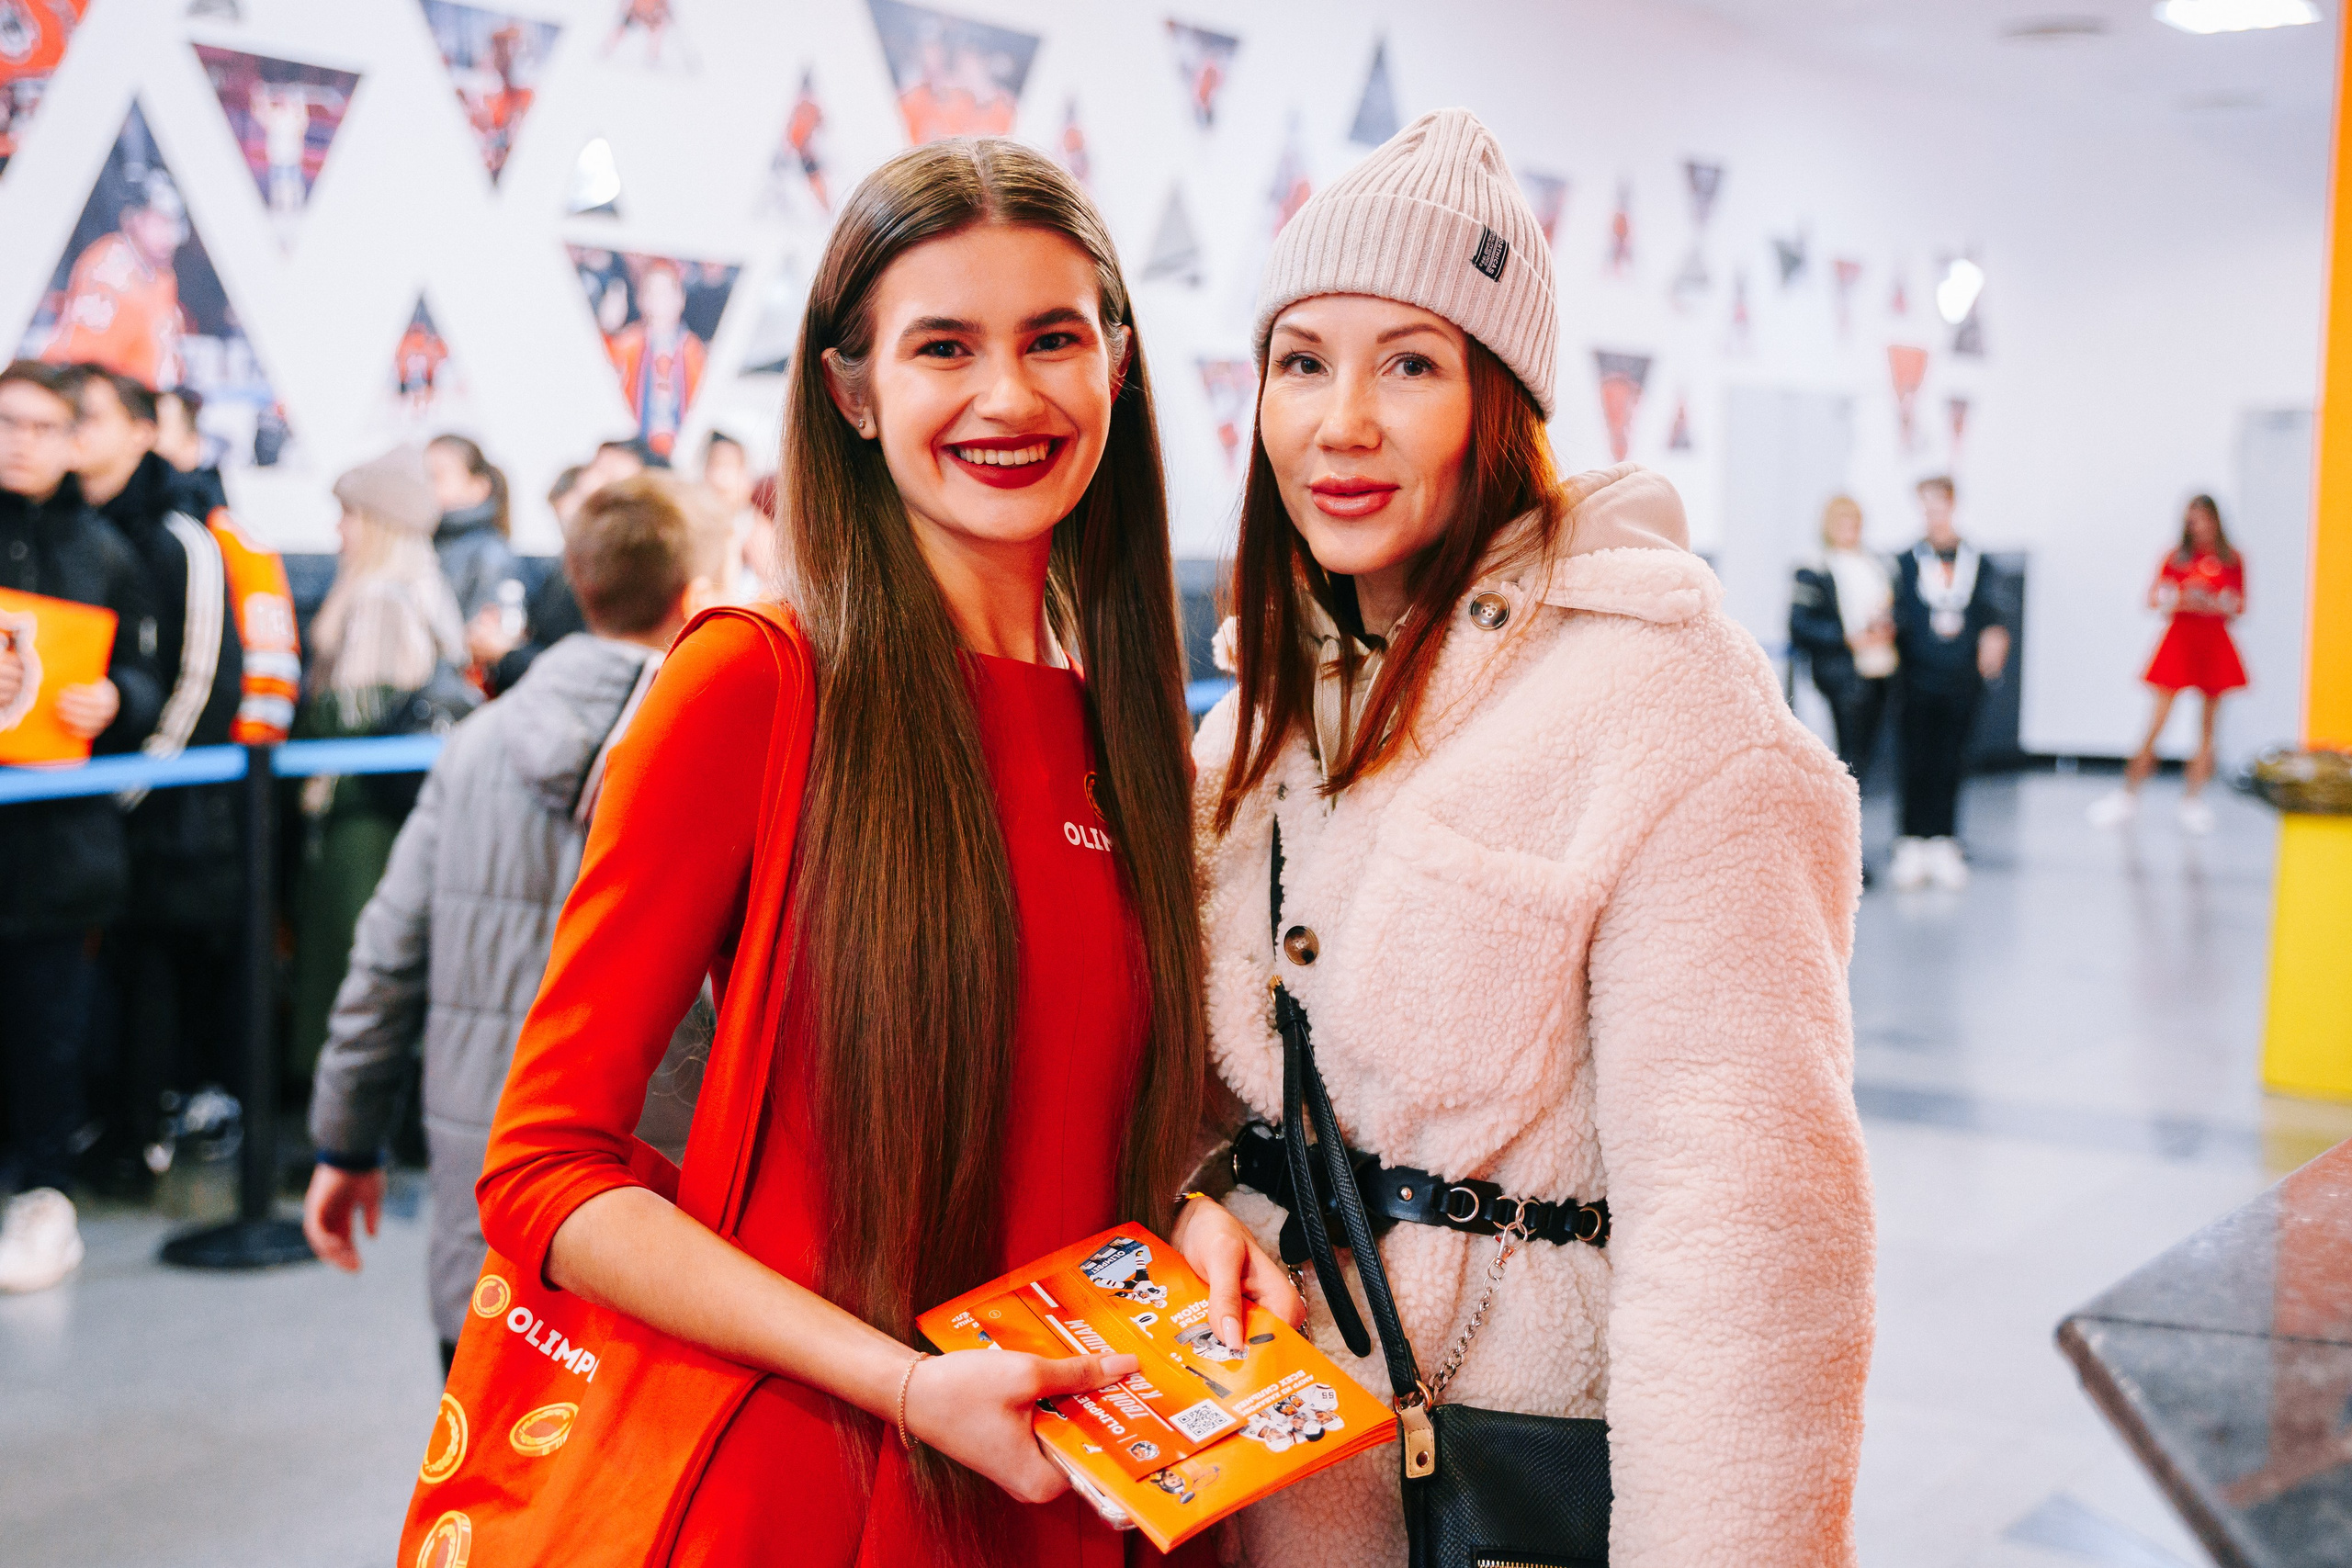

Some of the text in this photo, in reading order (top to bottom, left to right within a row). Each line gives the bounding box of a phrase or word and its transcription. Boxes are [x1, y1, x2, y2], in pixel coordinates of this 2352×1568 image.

[1487, 238, 1504, 275] ORTHICAS
[1091, 1250, 1125, 1275] OLIMPBET
[507, 1306, 601, 1384] OLIMP
[1278, 1369, 1306, 1388] ВСЕХ
[1280, 1385, 1293, 1394] ИЗ
[1292, 1373, 1315, 1389] АМУР
[1137, 1389, 1164, 1400] К
[1102, 1392, 1149, 1420] ТВОЙ
